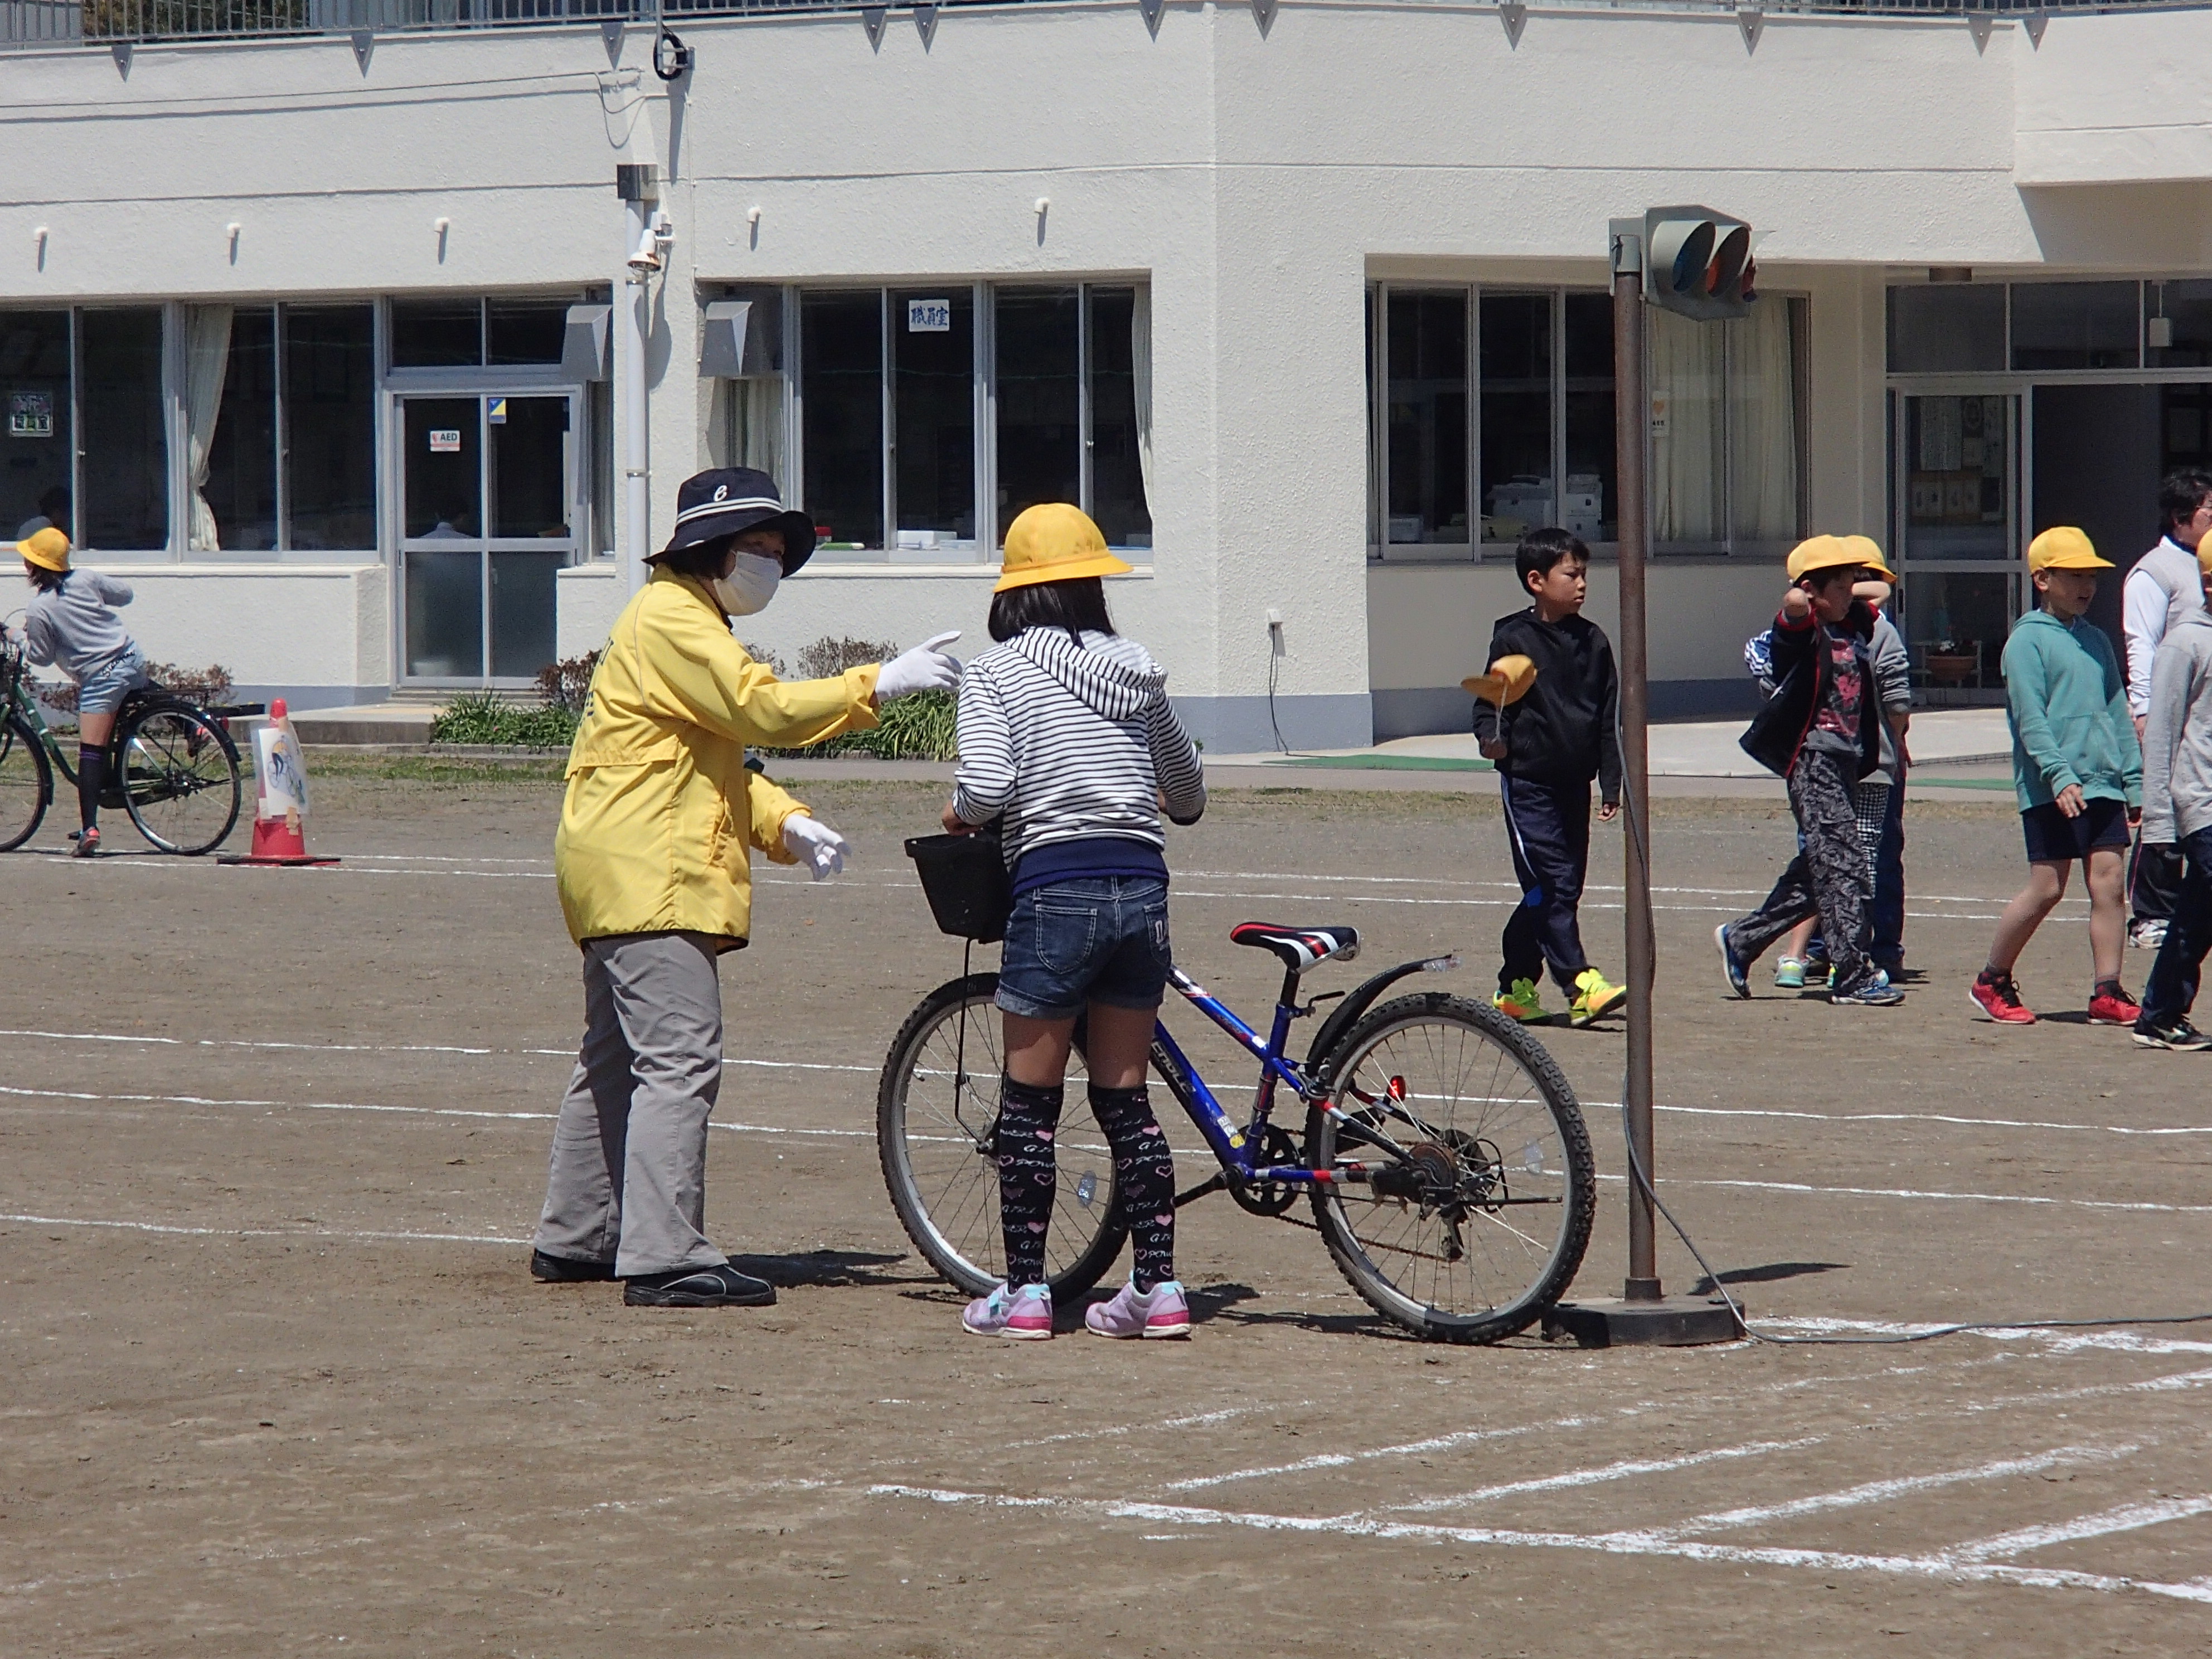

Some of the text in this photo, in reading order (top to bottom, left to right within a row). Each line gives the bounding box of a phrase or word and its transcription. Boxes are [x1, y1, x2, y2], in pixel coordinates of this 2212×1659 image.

[910, 305, 948, 326] 職員室
[440, 433, 457, 441] AED
